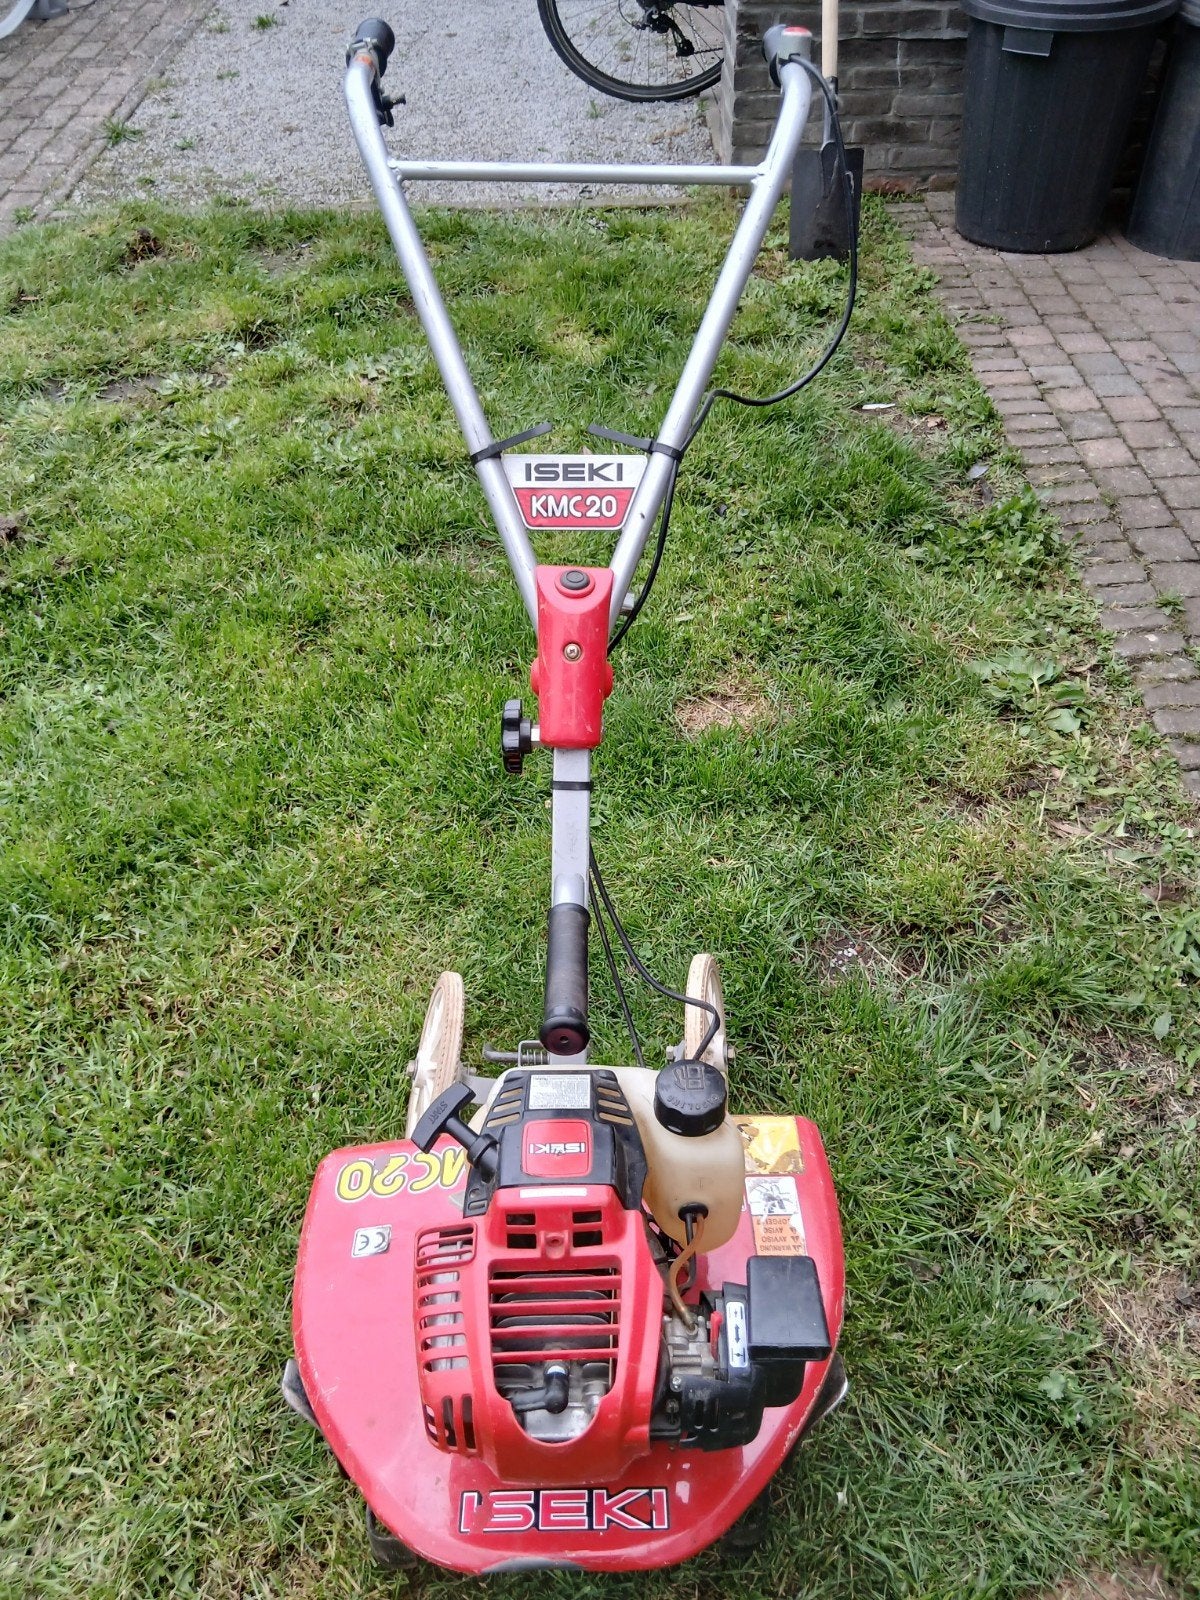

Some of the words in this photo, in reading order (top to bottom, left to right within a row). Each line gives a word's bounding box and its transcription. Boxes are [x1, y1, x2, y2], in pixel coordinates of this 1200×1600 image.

[524, 462, 623, 482] ISEKI
[531, 493, 617, 519] KMC20
[428, 1100, 448, 1125] START
[666, 1094, 719, 1111] GASOLINE
[358, 1231, 386, 1252] CE
[460, 1487, 669, 1532] ISEKI
